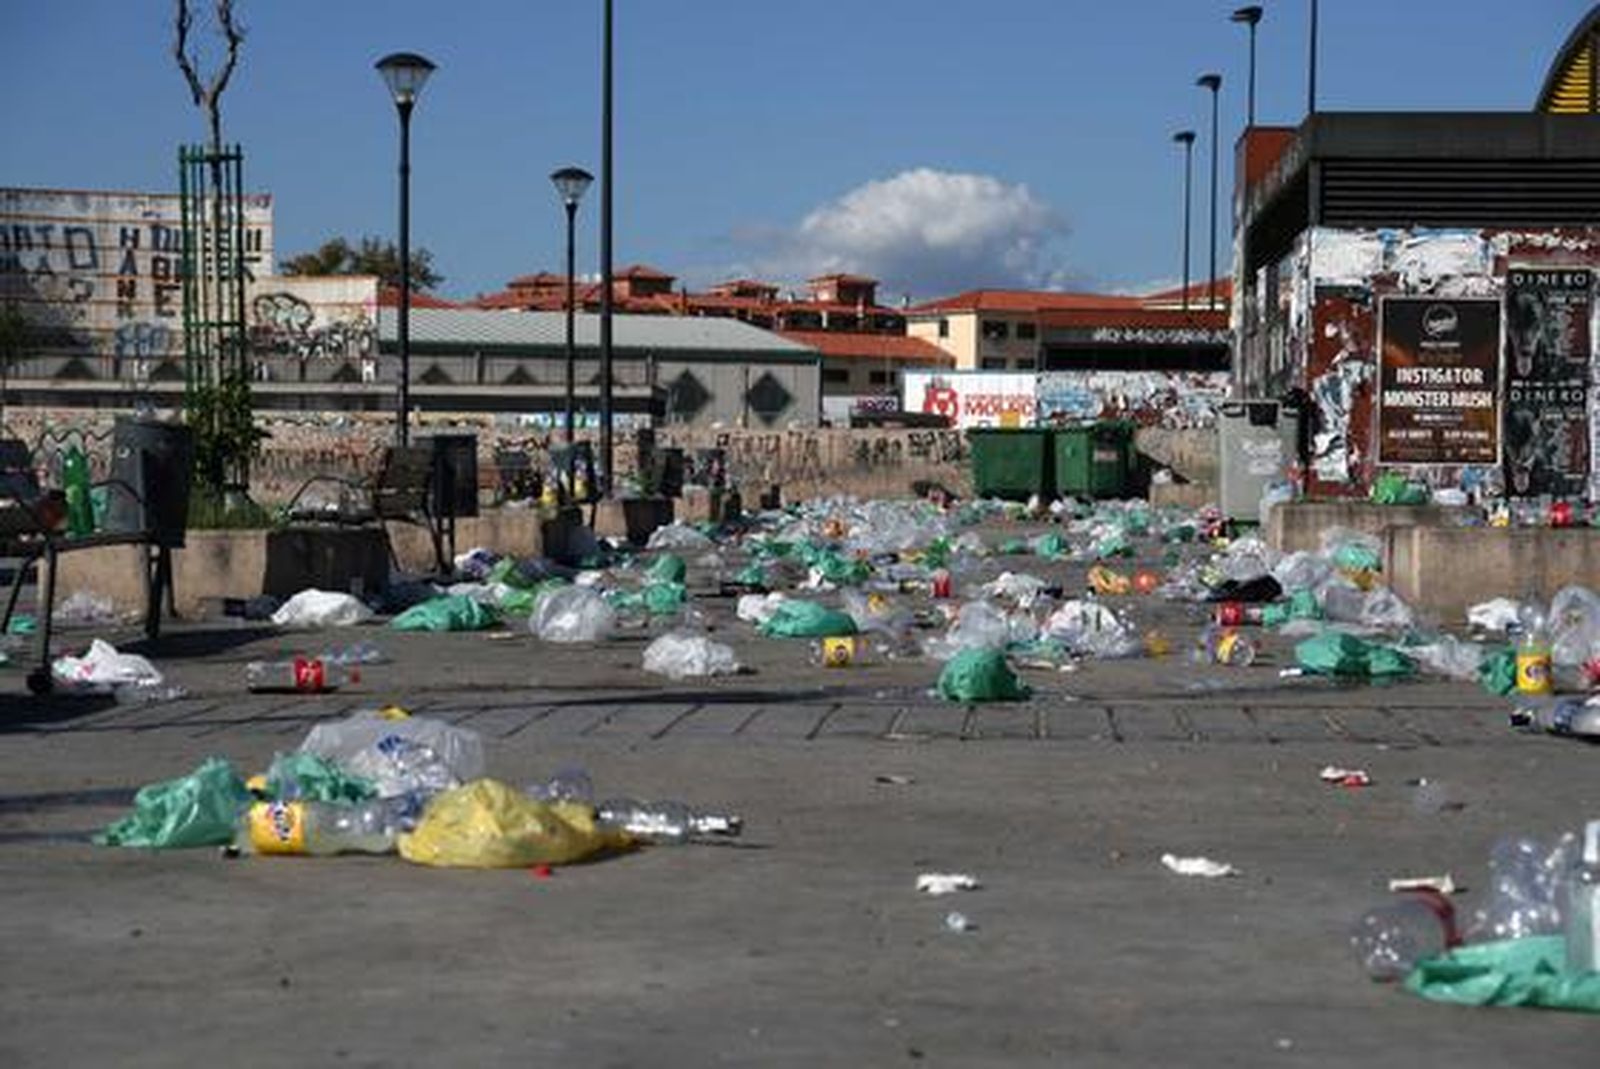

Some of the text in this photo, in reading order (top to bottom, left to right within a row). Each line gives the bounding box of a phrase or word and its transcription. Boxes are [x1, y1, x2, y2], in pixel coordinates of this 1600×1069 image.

[1512, 273, 1587, 286] DINERO
[1396, 367, 1484, 384] INSTIGATOR
[1384, 390, 1493, 407] MONSTER MUSH
[1510, 388, 1585, 402] DINERO
